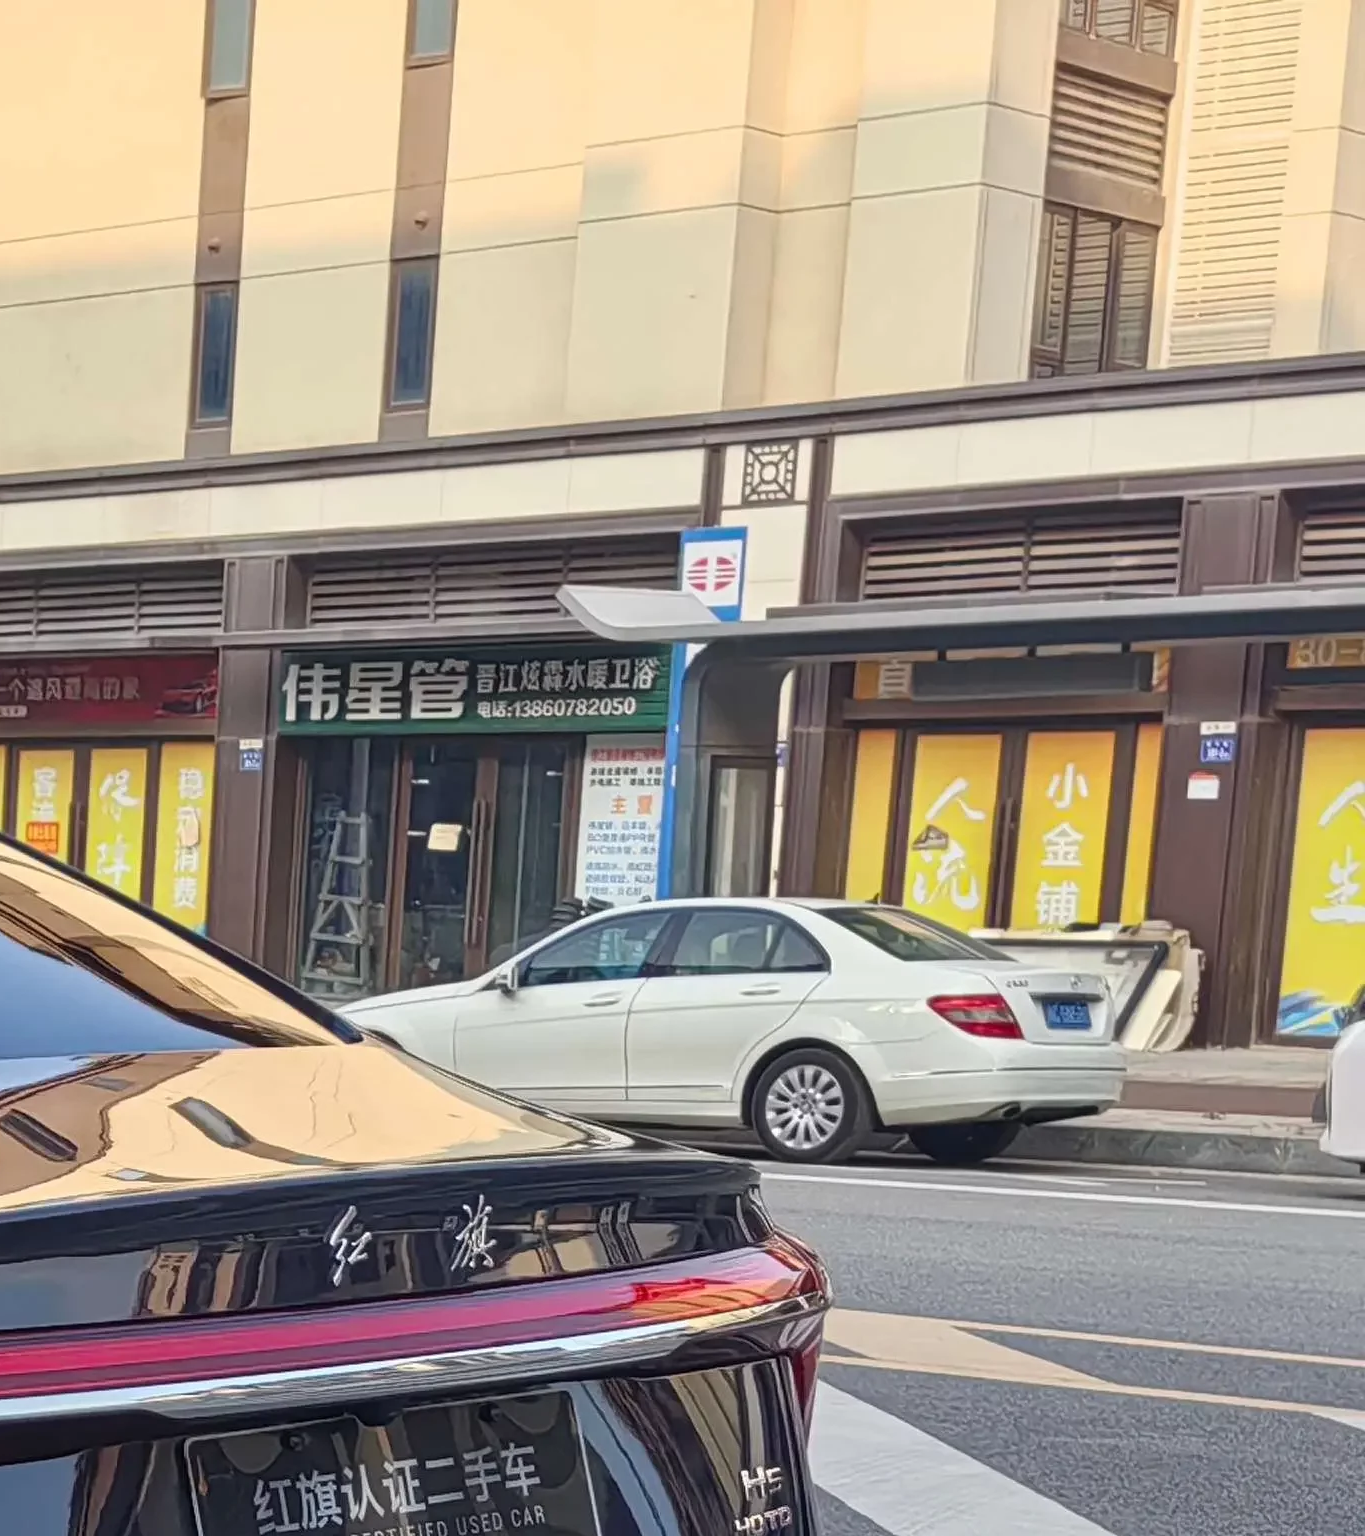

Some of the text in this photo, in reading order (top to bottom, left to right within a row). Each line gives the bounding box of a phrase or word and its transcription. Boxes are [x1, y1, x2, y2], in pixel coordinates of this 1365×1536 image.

[281, 657, 469, 722] 伟星管
[253, 1442, 542, 1536] 红旗认证二手车
[740, 1465, 782, 1501] H5
[455, 1511, 504, 1536] USED
[511, 1503, 547, 1529] CAR
